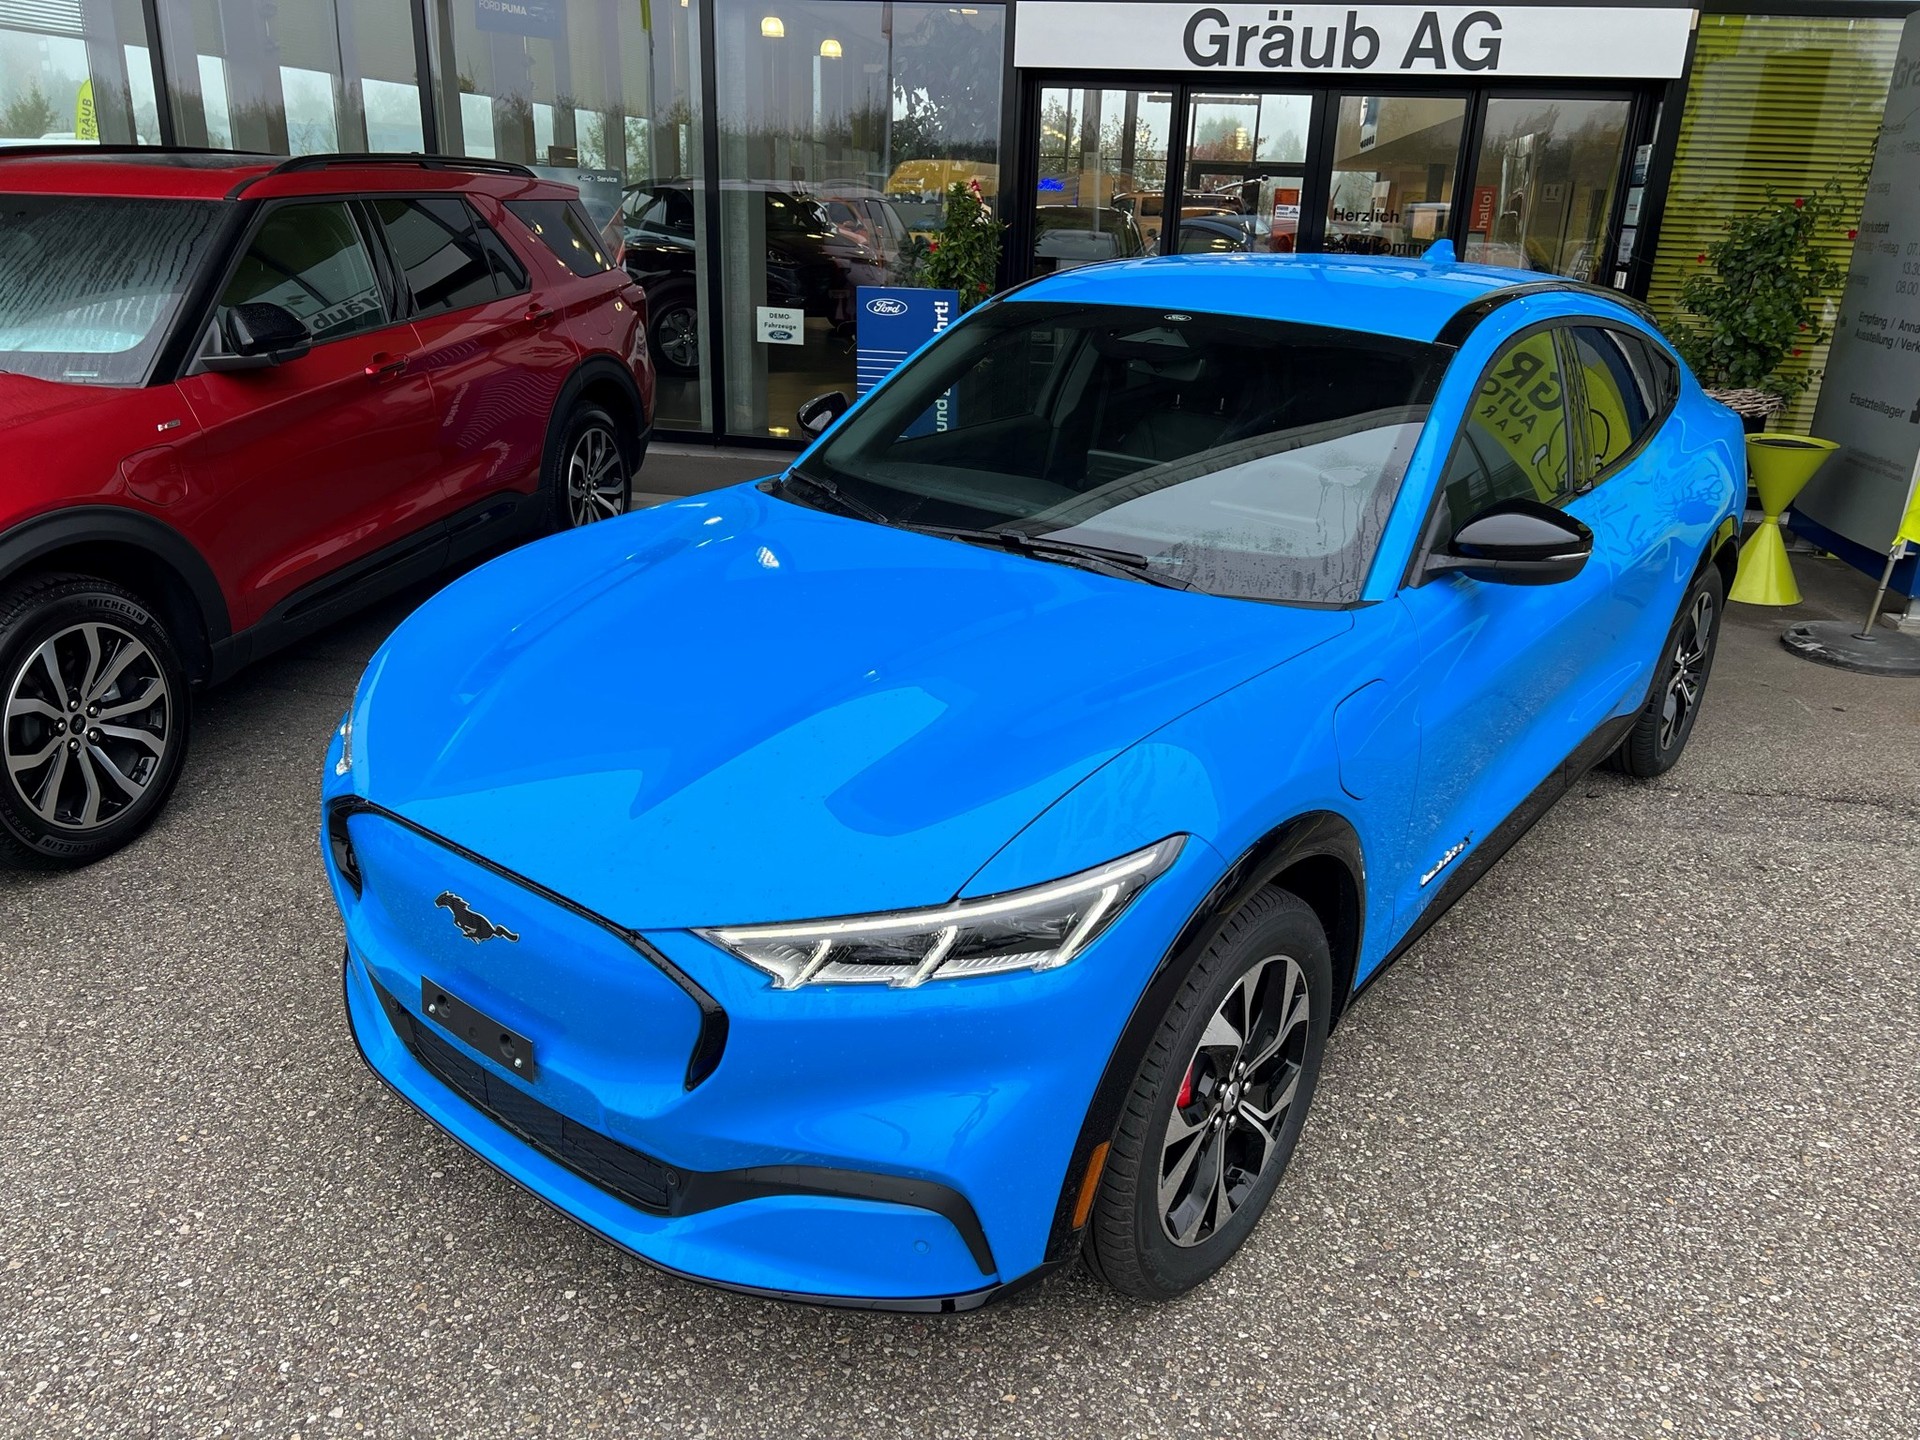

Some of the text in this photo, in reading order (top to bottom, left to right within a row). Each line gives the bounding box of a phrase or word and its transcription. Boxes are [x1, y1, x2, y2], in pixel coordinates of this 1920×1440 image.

[479, 0, 527, 16] FORD PUMA
[1183, 8, 1503, 70] Gräub AG
[596, 175, 618, 183] Service
[1333, 207, 1400, 224] Herzlich
[1476, 191, 1493, 229] hallo!
[872, 300, 901, 314] Ford
[764, 321, 797, 331] Fahrzeuge
[1858, 311, 1888, 331] Empfang
[1854, 327, 1894, 350] Ausstellung
[936, 400, 949, 432] und
[1848, 392, 1906, 419] Ersatzteillager
[87, 598, 146, 622] MICHELIN
